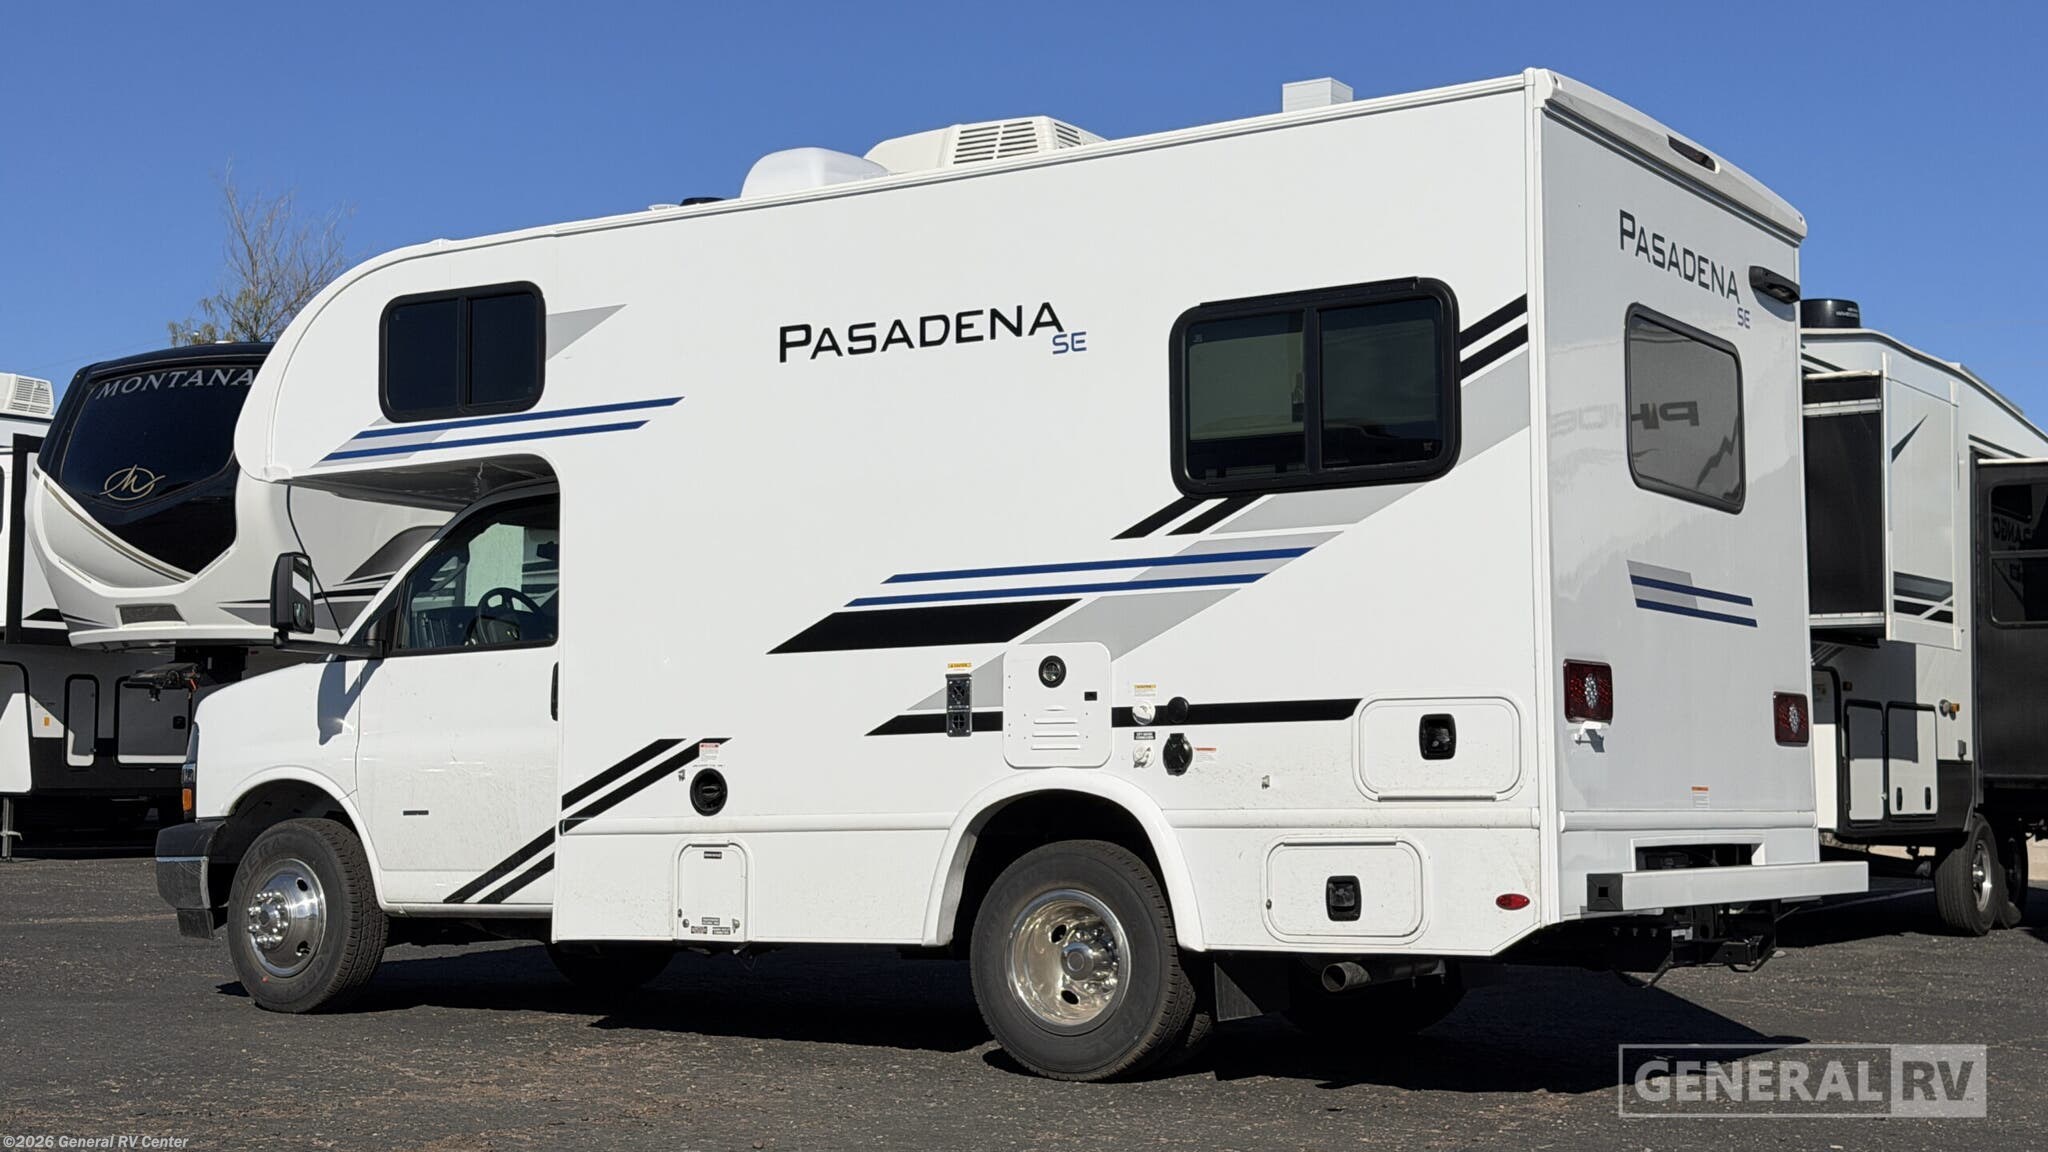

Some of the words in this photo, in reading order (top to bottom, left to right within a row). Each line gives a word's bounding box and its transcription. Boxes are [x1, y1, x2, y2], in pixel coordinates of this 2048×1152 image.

[1619, 209, 1740, 304] PASADENA
[1737, 307, 1751, 329] SE
[779, 302, 1064, 363] PASADENA
[1052, 331, 1087, 354] SE
[96, 369, 255, 400] MONTANA
